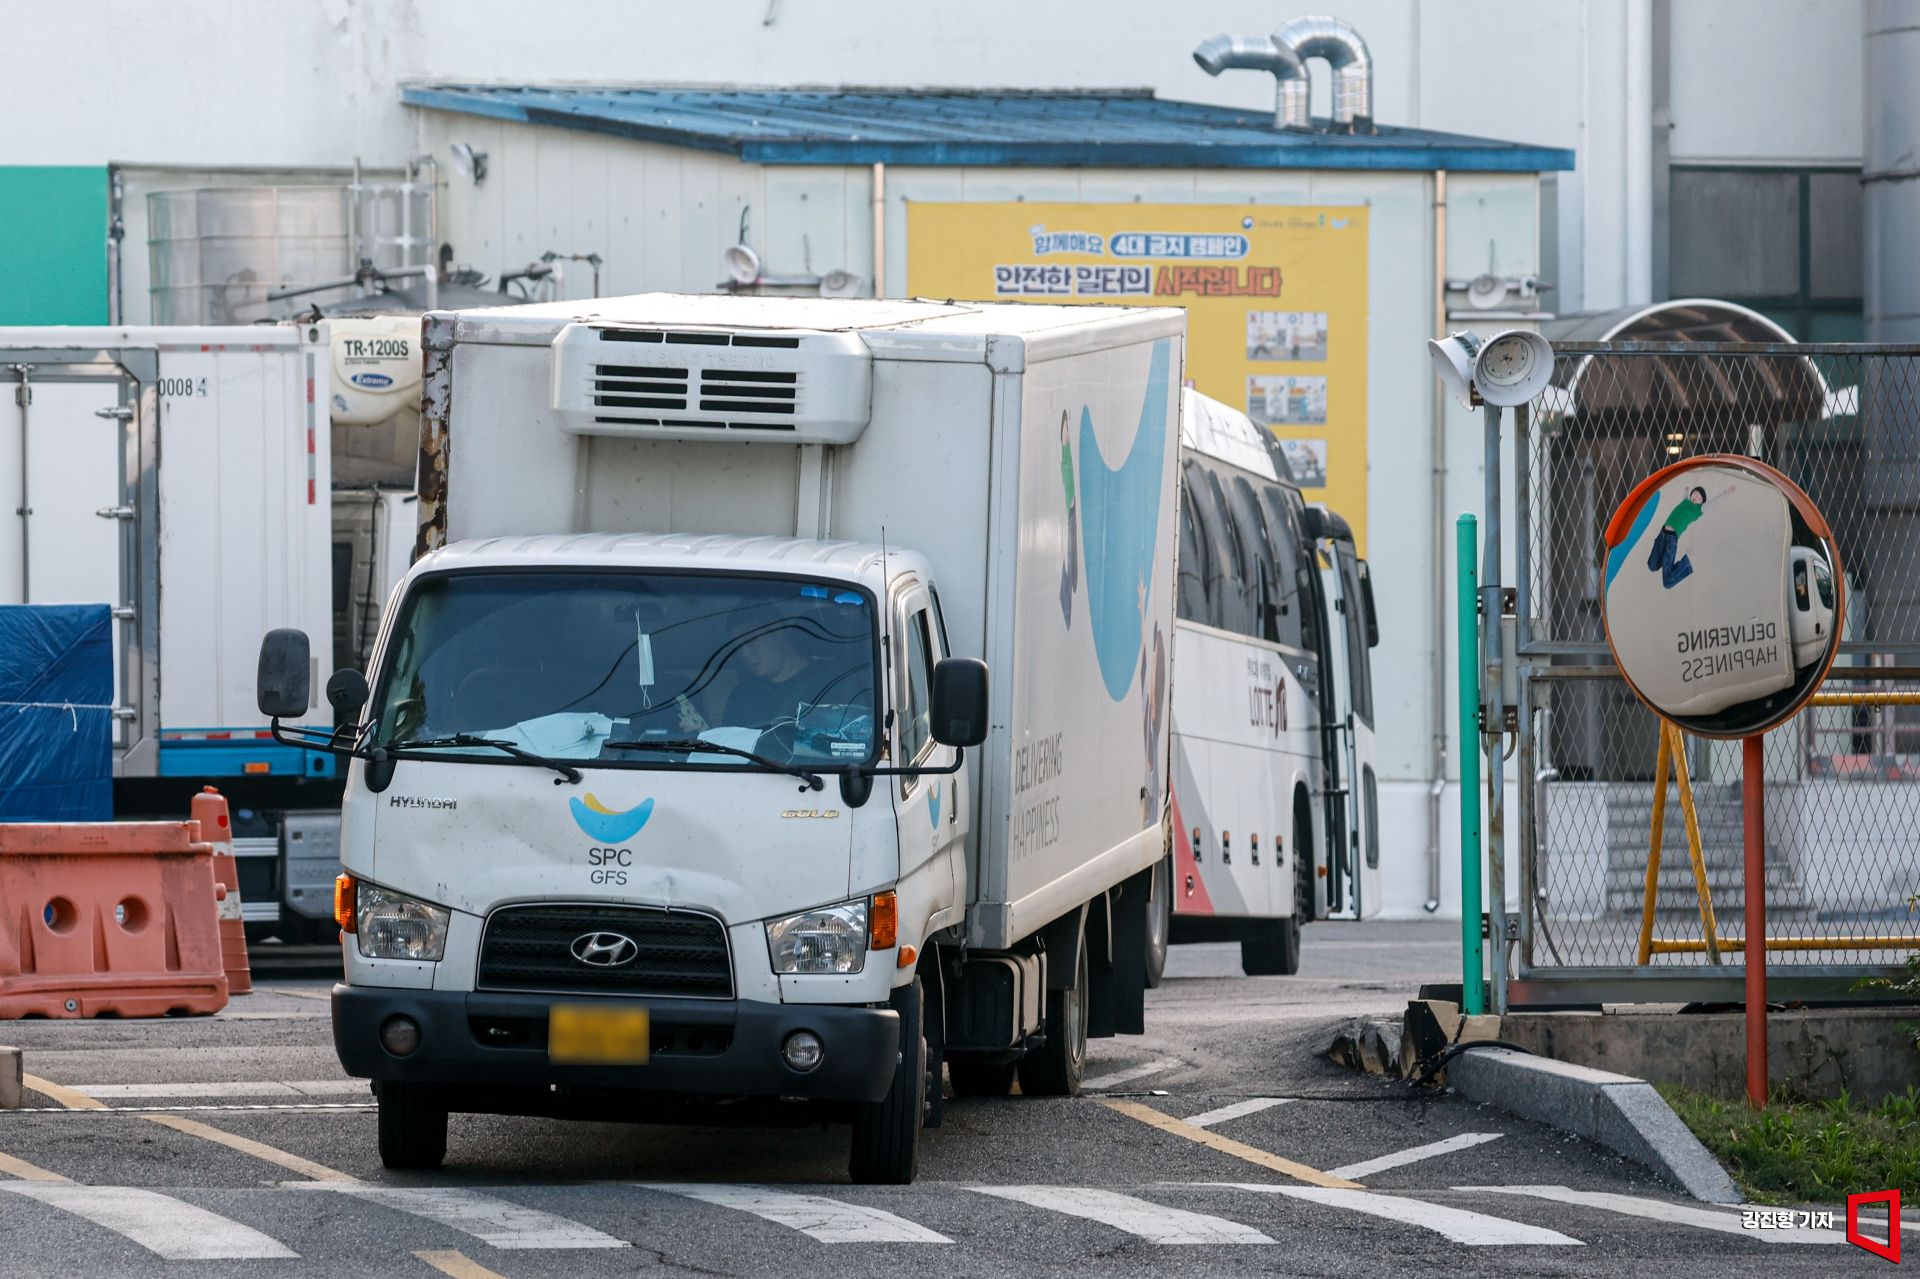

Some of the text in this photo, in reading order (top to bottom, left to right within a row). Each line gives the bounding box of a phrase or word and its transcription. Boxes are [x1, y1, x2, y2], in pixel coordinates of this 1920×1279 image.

[1150, 236, 1185, 256] 금지
[1189, 236, 1242, 256] 캠페인
[996, 266, 1283, 297] 안전한 일터의 시작입니다
[344, 339, 409, 356] TR-1200S
[1015, 731, 1063, 794] DELIVERING
[390, 795, 457, 810] HYUNDAI
[781, 809, 840, 819] GOLD
[1013, 795, 1060, 863] HAPPINESS
[588, 848, 632, 867] SPC
[590, 869, 628, 886] GFS
